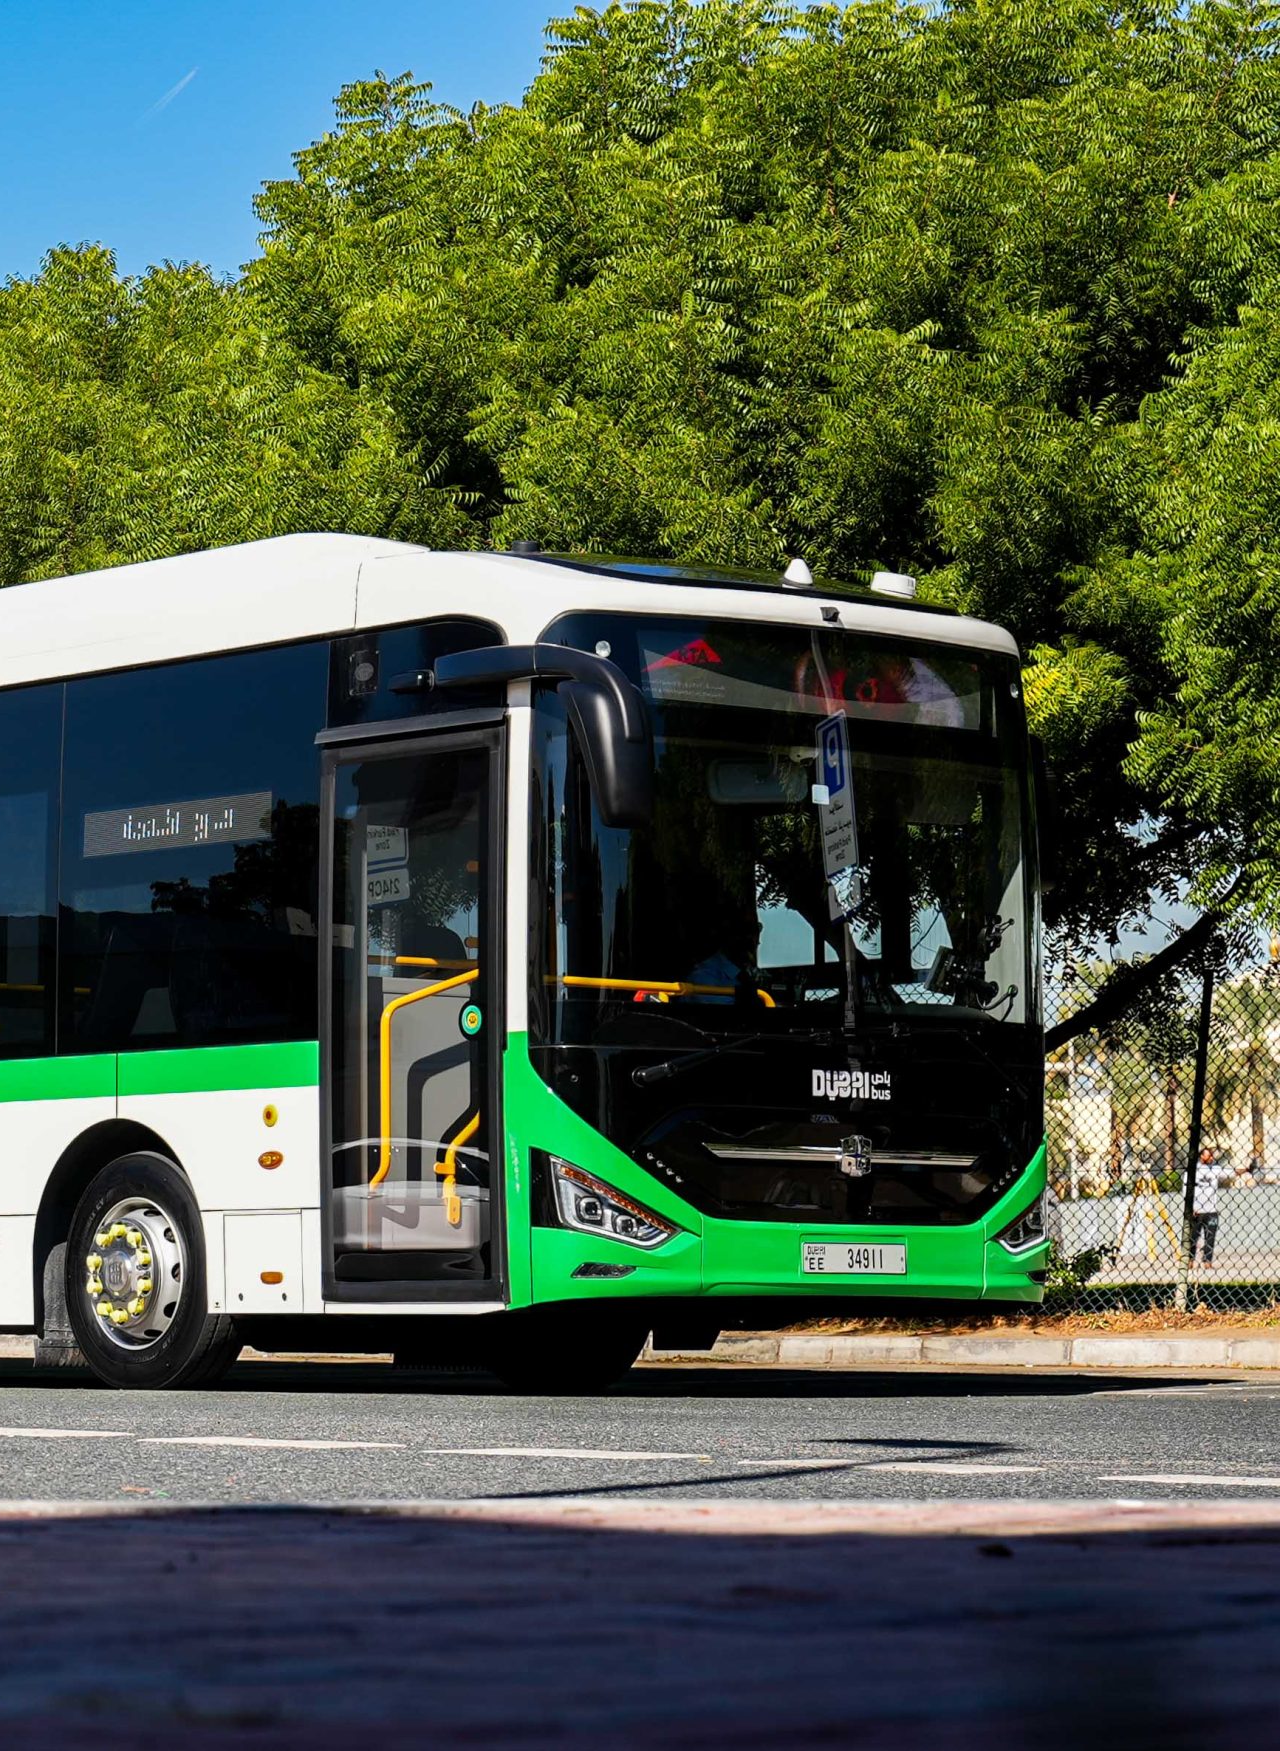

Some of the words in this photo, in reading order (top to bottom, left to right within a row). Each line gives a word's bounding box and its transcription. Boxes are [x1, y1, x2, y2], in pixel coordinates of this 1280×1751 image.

[811, 1068, 870, 1101] DUBAI
[871, 1070, 891, 1087] باص
[871, 1085, 891, 1100] bus
[808, 1257, 825, 1271] EE
[847, 1248, 883, 1270] 34911
